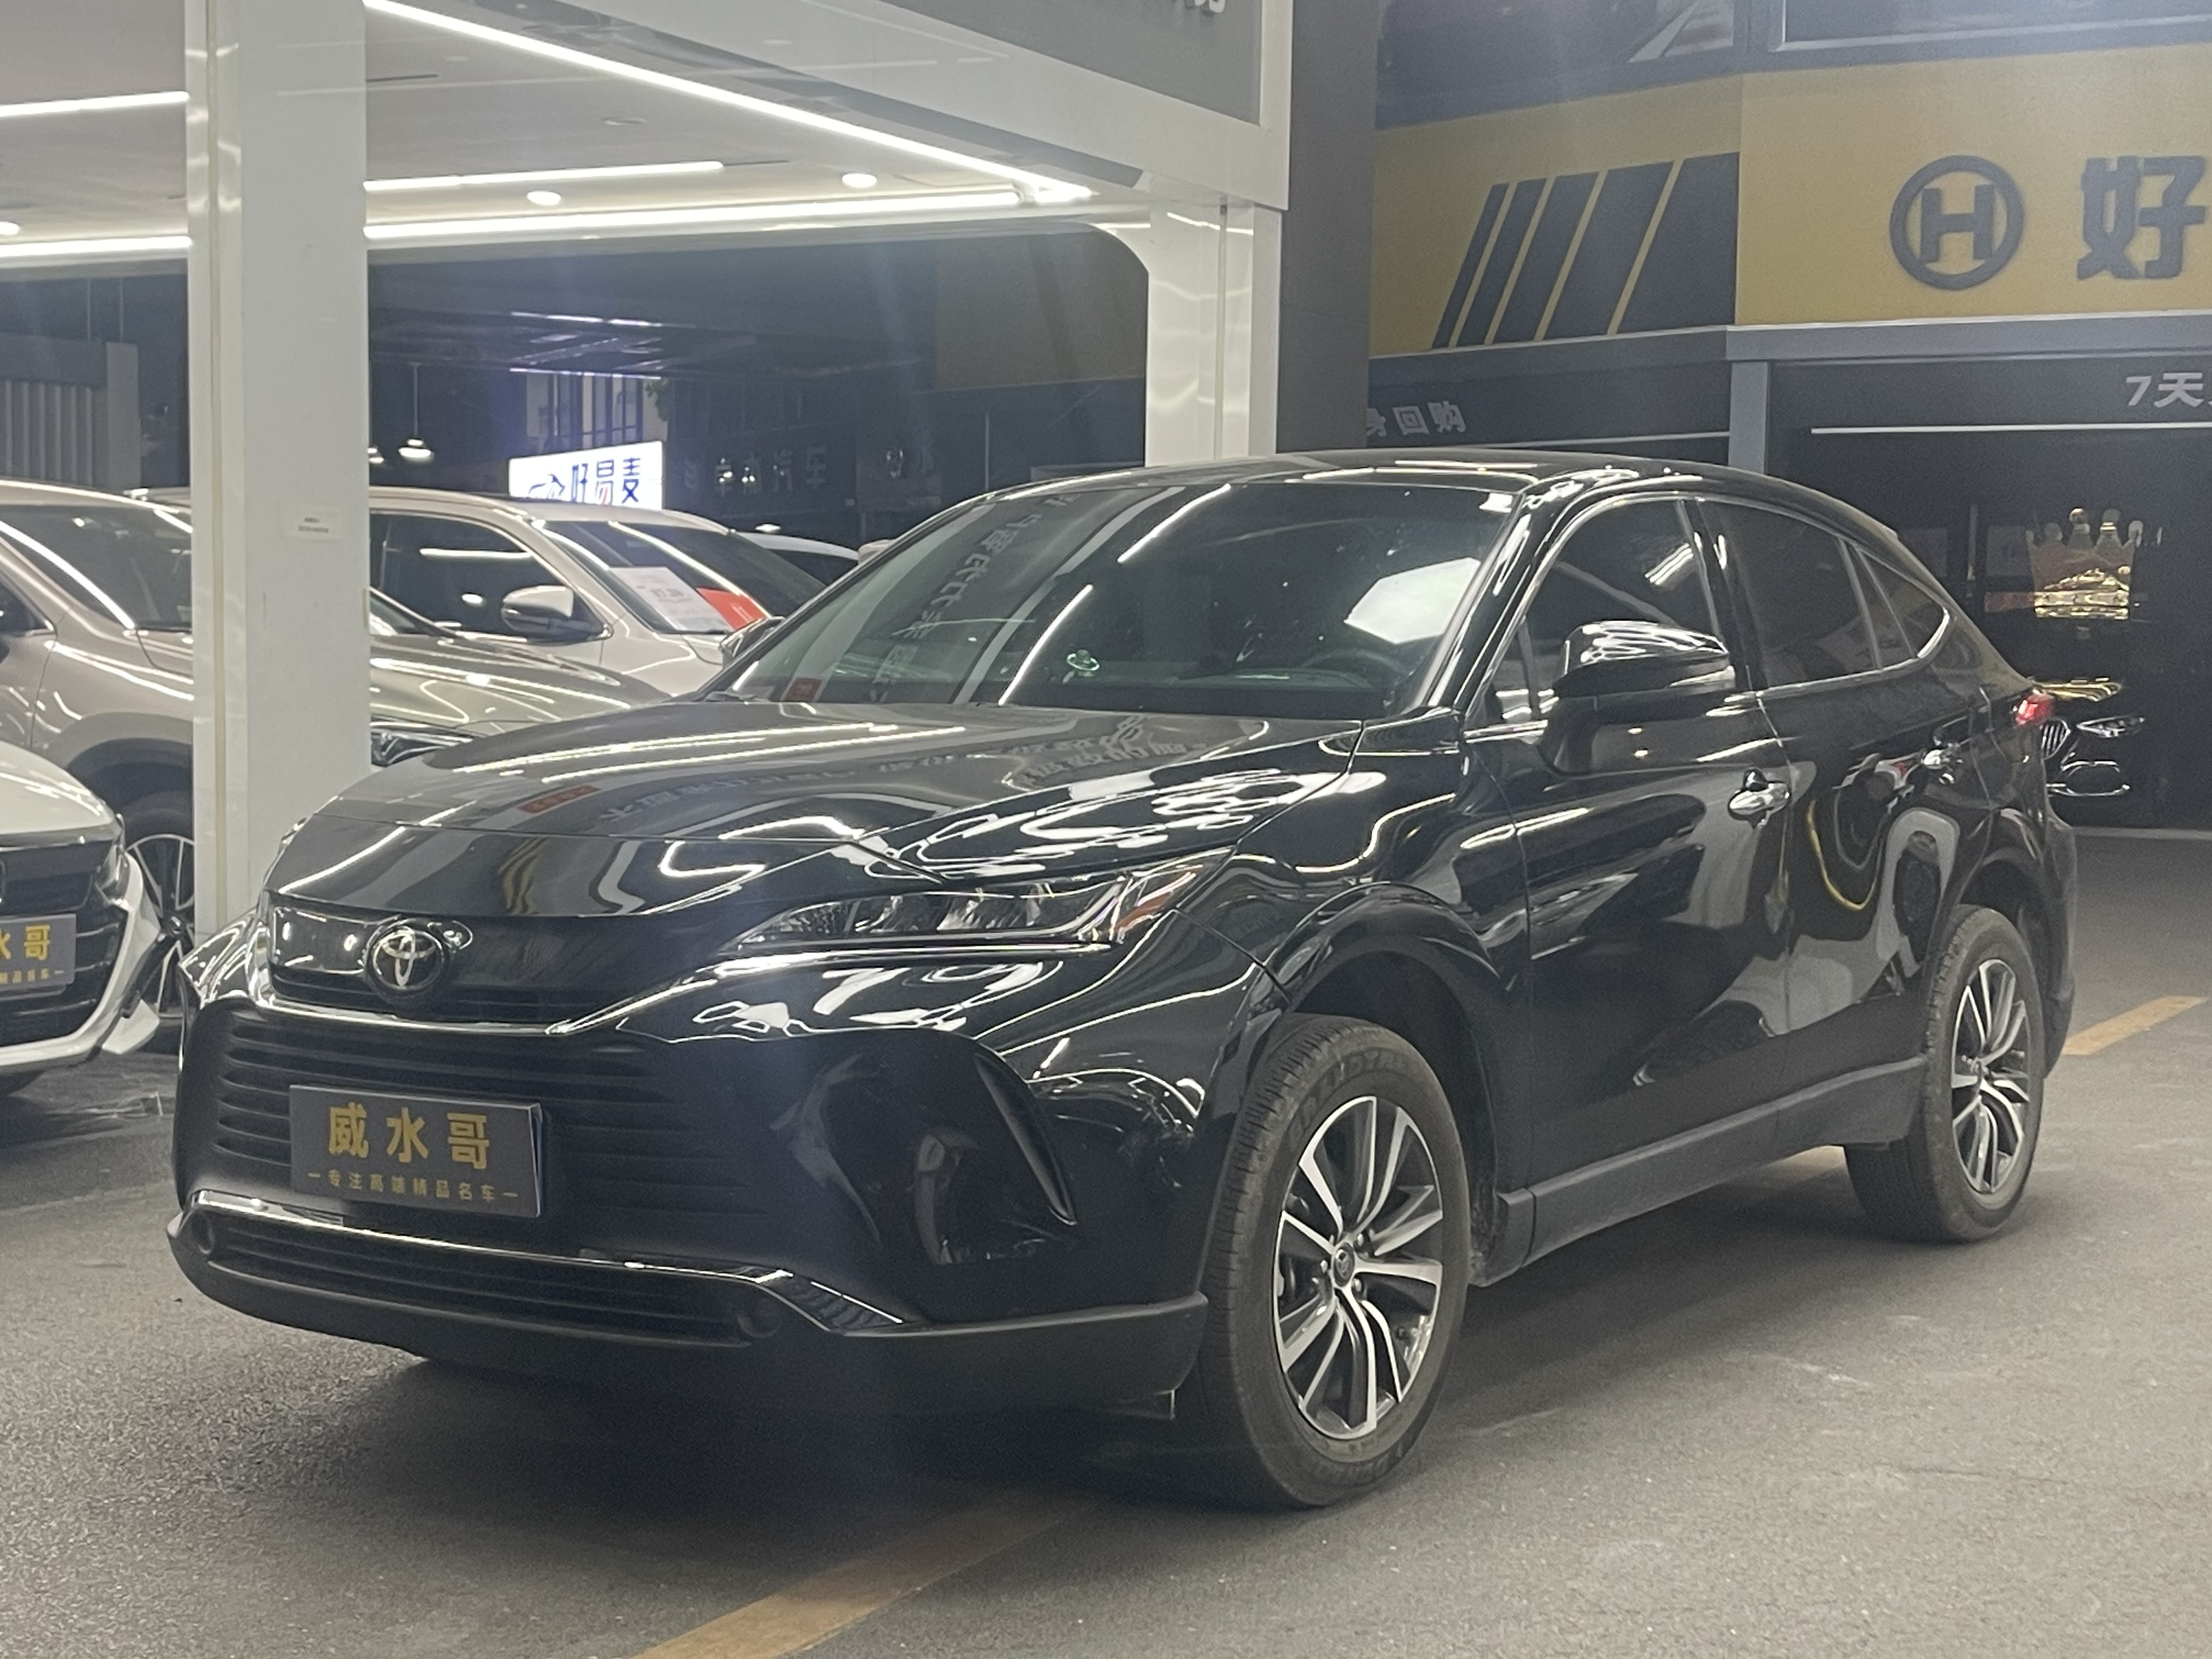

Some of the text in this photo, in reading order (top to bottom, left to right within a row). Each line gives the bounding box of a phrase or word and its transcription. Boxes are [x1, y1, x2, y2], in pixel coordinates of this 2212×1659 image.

[2077, 156, 2205, 281] 好
[2126, 372, 2212, 408] 7天
[329, 1102, 490, 1169] 威水哥
